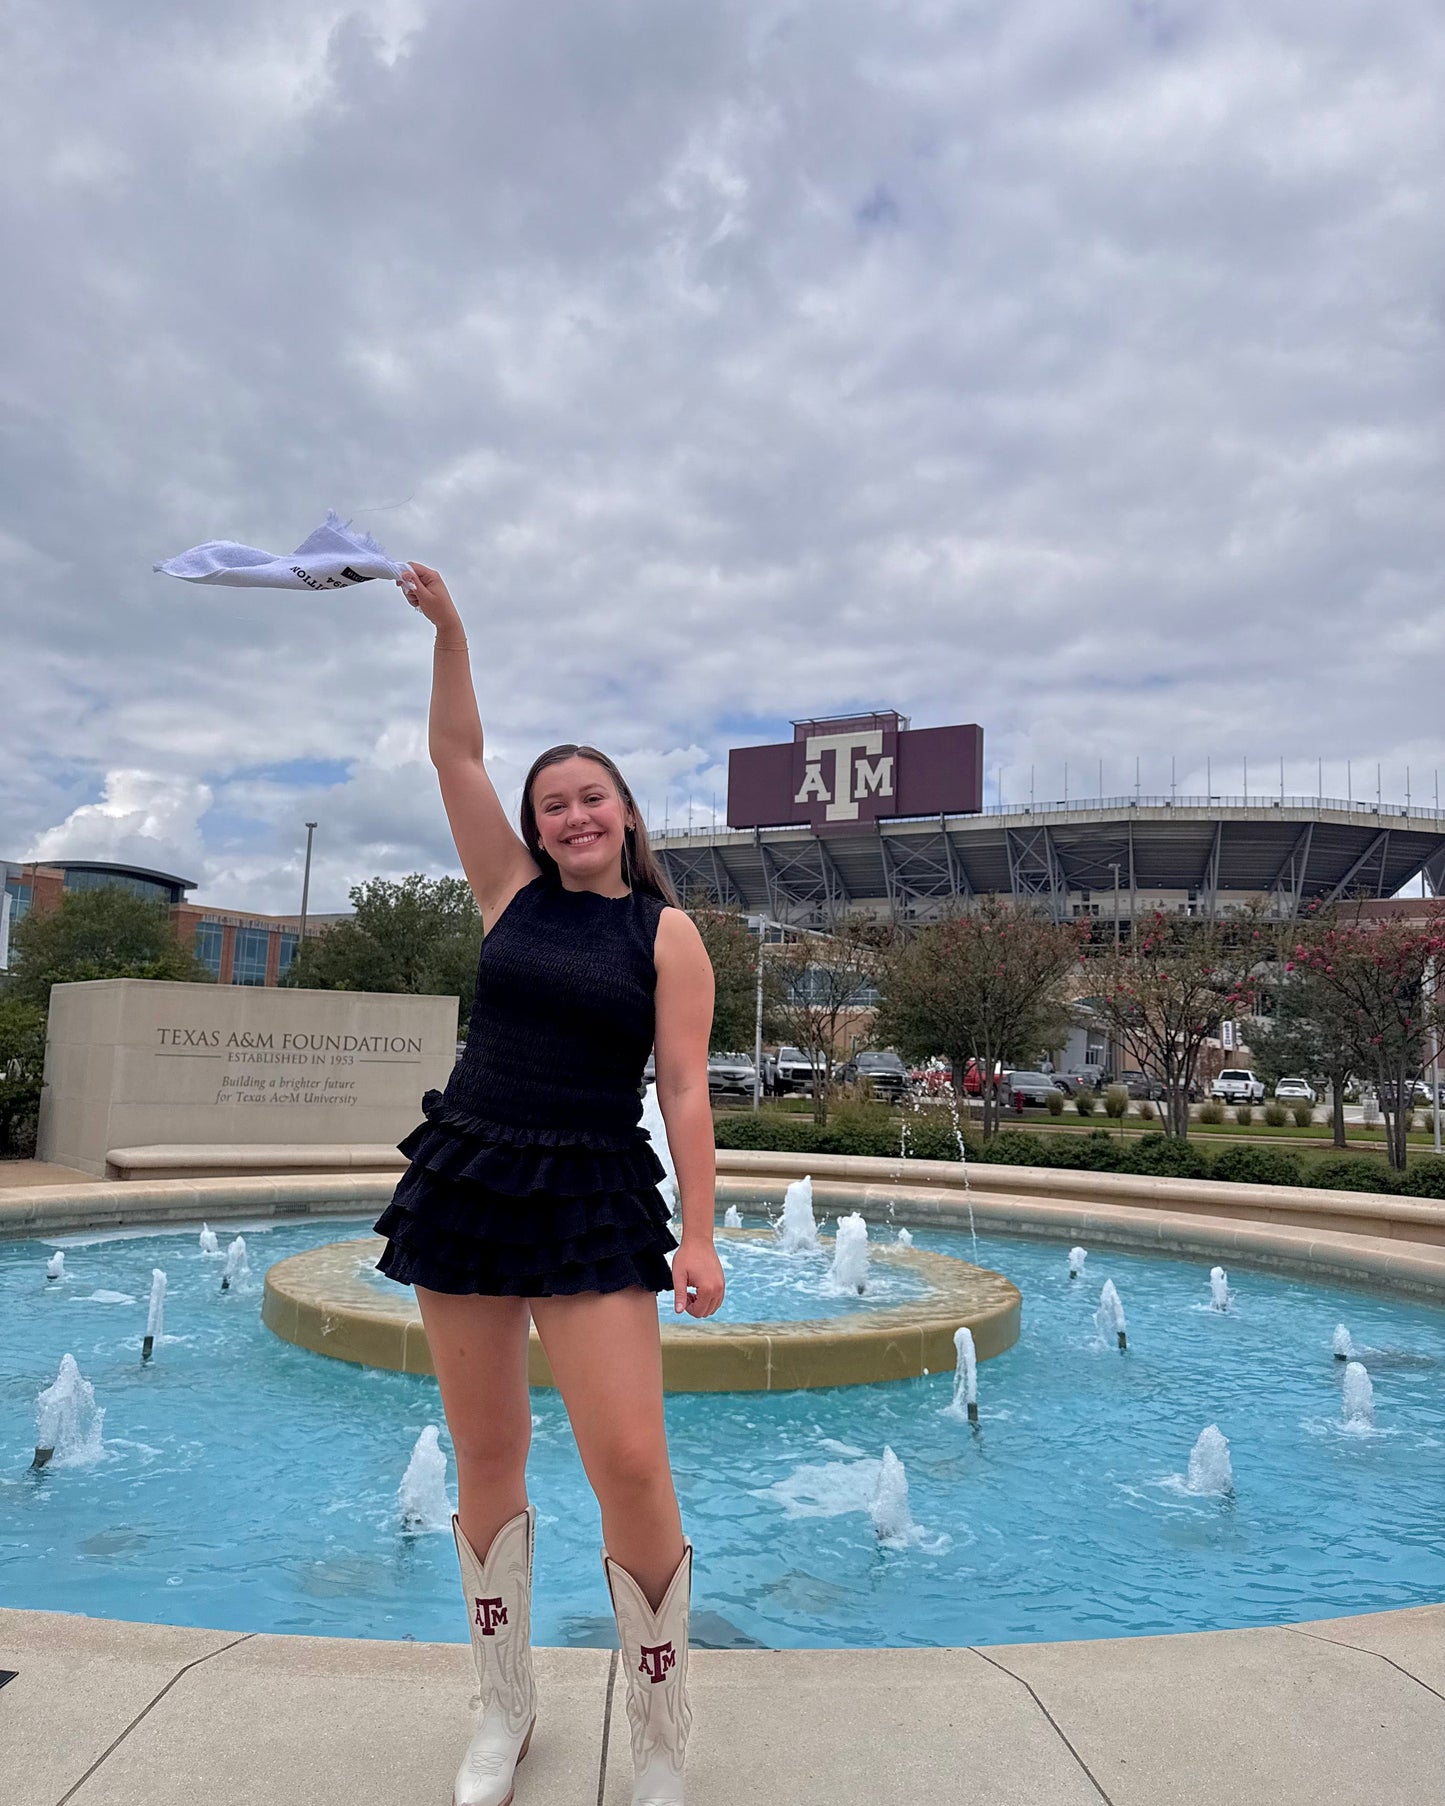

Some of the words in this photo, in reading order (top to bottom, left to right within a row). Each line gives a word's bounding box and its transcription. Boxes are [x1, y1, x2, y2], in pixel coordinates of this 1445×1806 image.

[290, 565, 330, 590] ITION
[157, 1028, 221, 1047] TEXAS
[225, 1031, 274, 1049] A&M
[282, 1033, 423, 1053] FOUNDATION
[227, 1052, 308, 1065] ESTABLISHED
[311, 1055, 326, 1065] IN
[330, 1055, 355, 1066] 1953
[222, 1076, 266, 1089] Building
[269, 1080, 276, 1088] a
[279, 1076, 320, 1091] brighter
[323, 1077, 356, 1091] future
[214, 1090, 231, 1105] for
[236, 1092, 267, 1103] Texas
[269, 1093, 300, 1103] A&M
[303, 1093, 359, 1106] University
